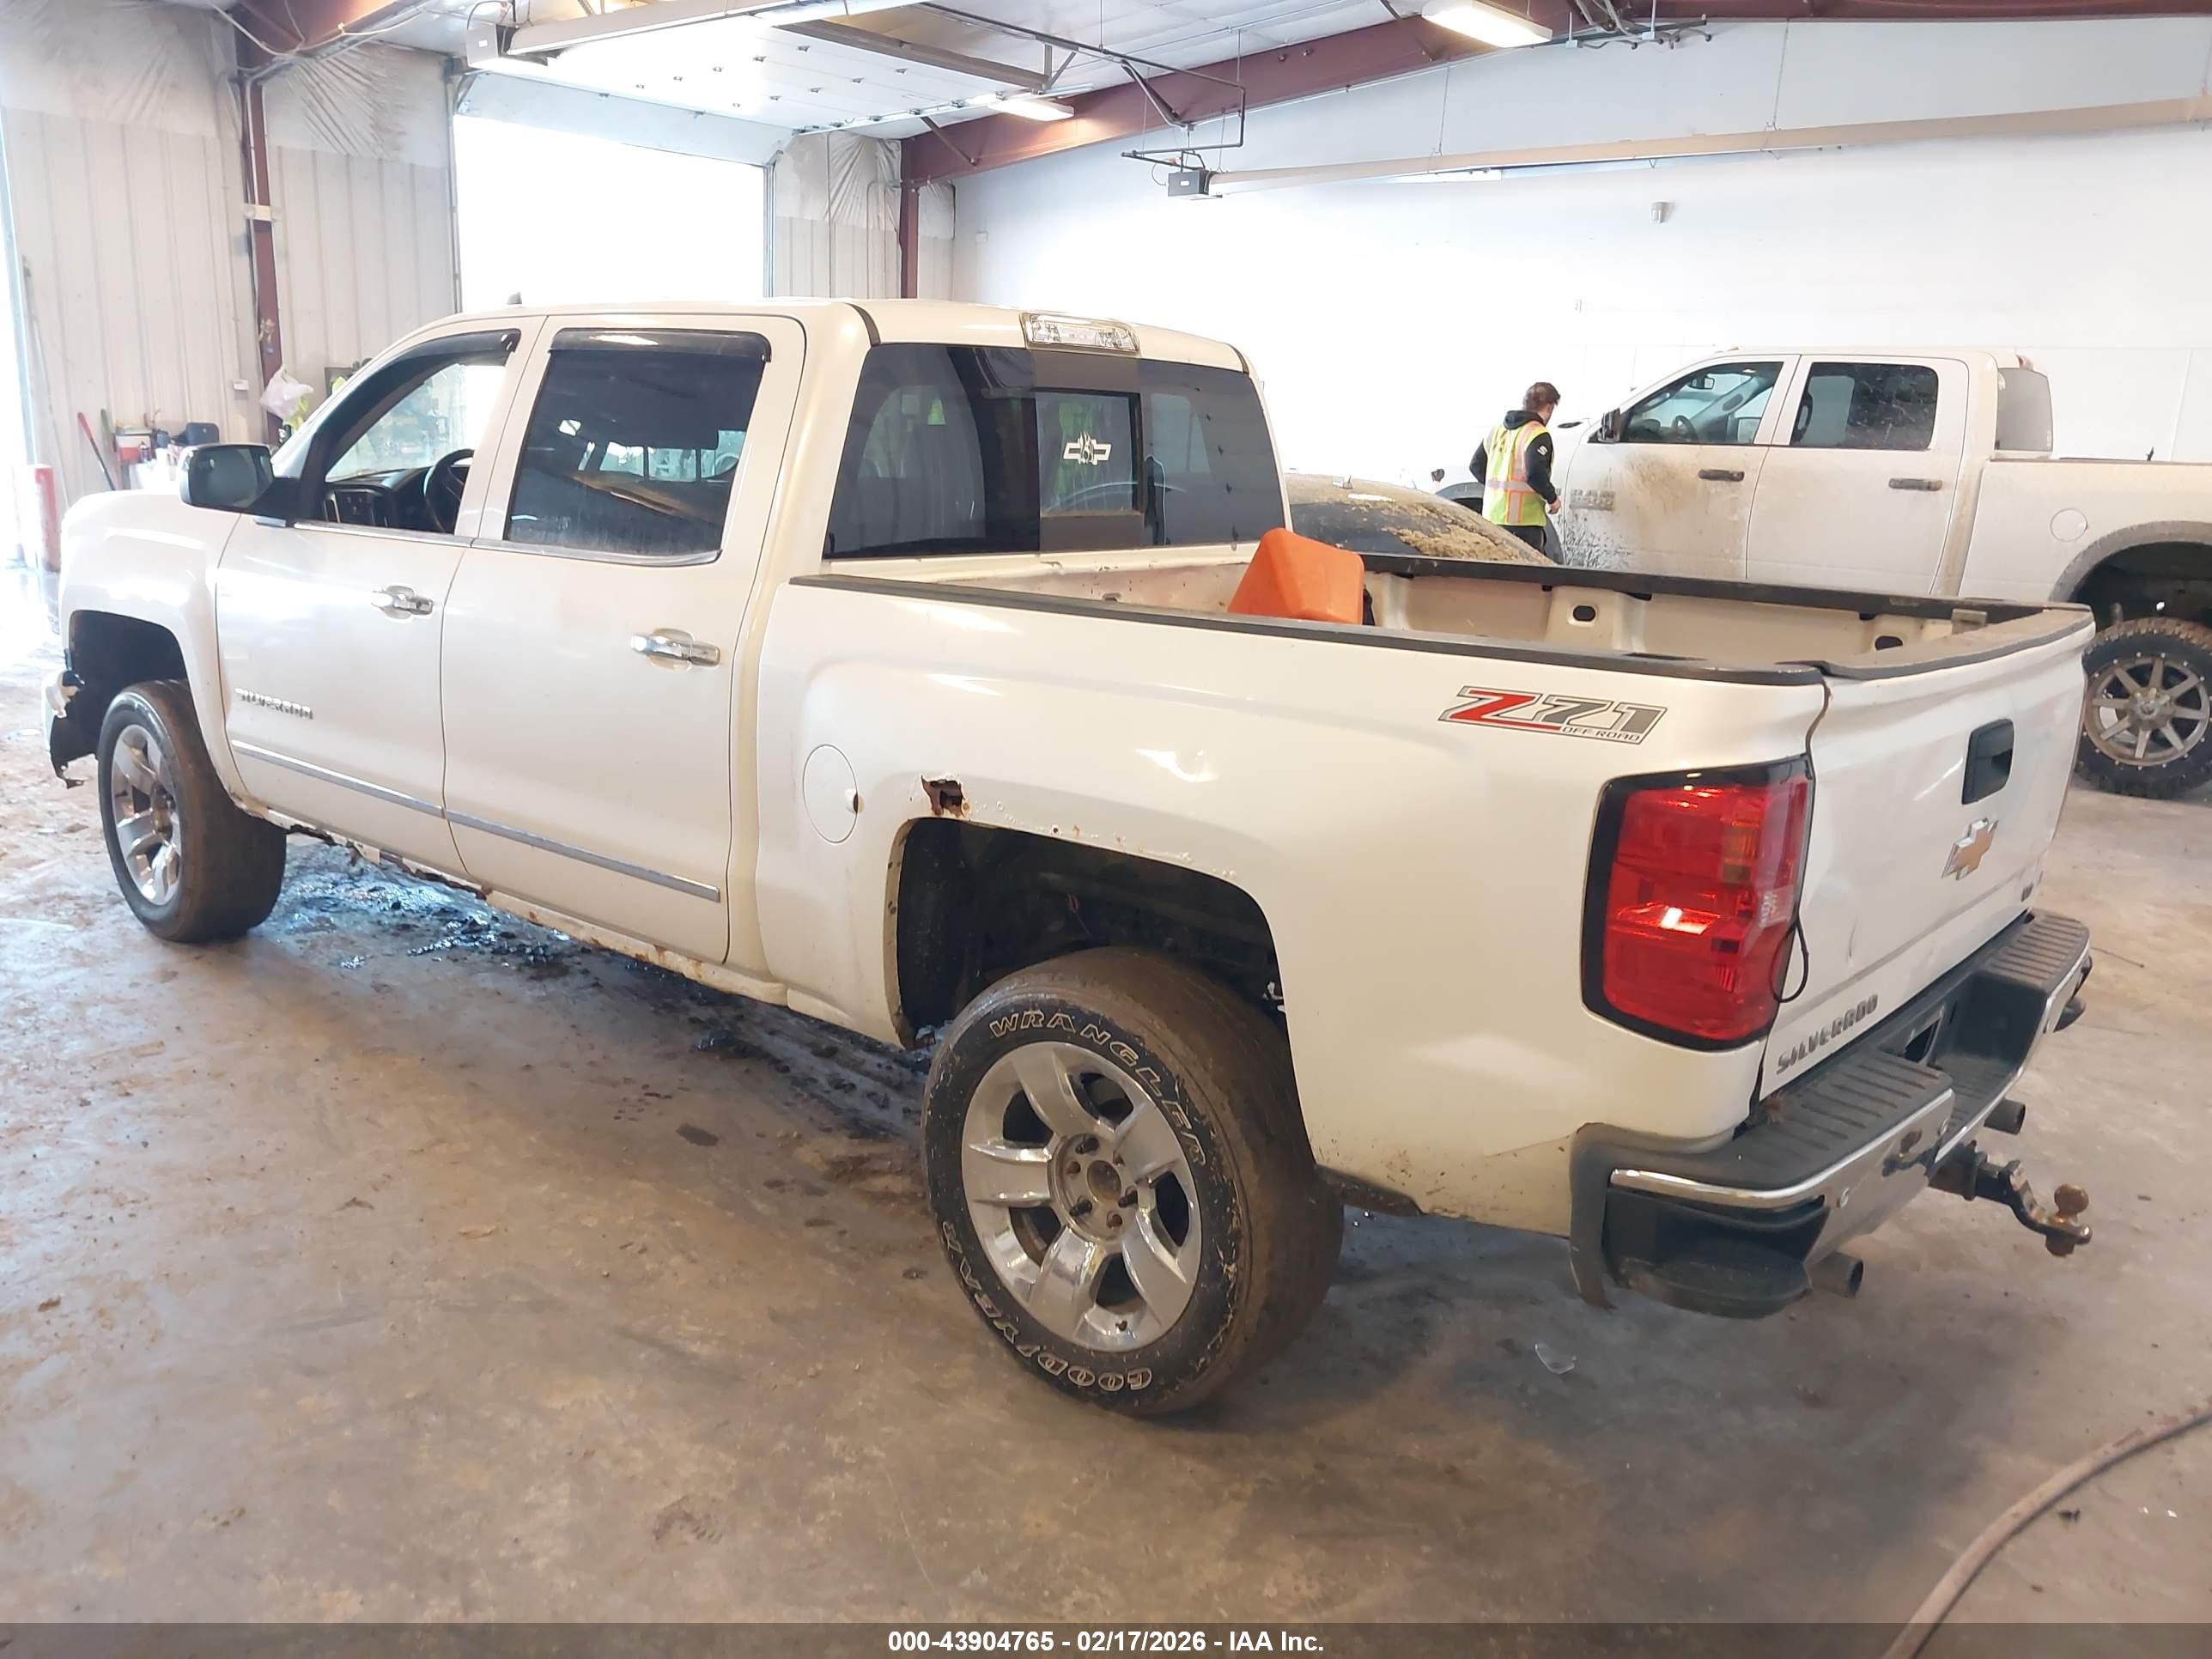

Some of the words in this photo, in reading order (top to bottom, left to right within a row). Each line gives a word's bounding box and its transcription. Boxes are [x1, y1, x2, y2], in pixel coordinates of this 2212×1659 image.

[1437, 685, 1668, 744] Z71
[1562, 726, 1593, 736] OFF
[1595, 730, 1640, 742] ROAD
[1776, 994, 1879, 1075] SILVERADO
[988, 1009, 1206, 1167] WRANGLER
[942, 1220, 1152, 1392] GOODYEAR
